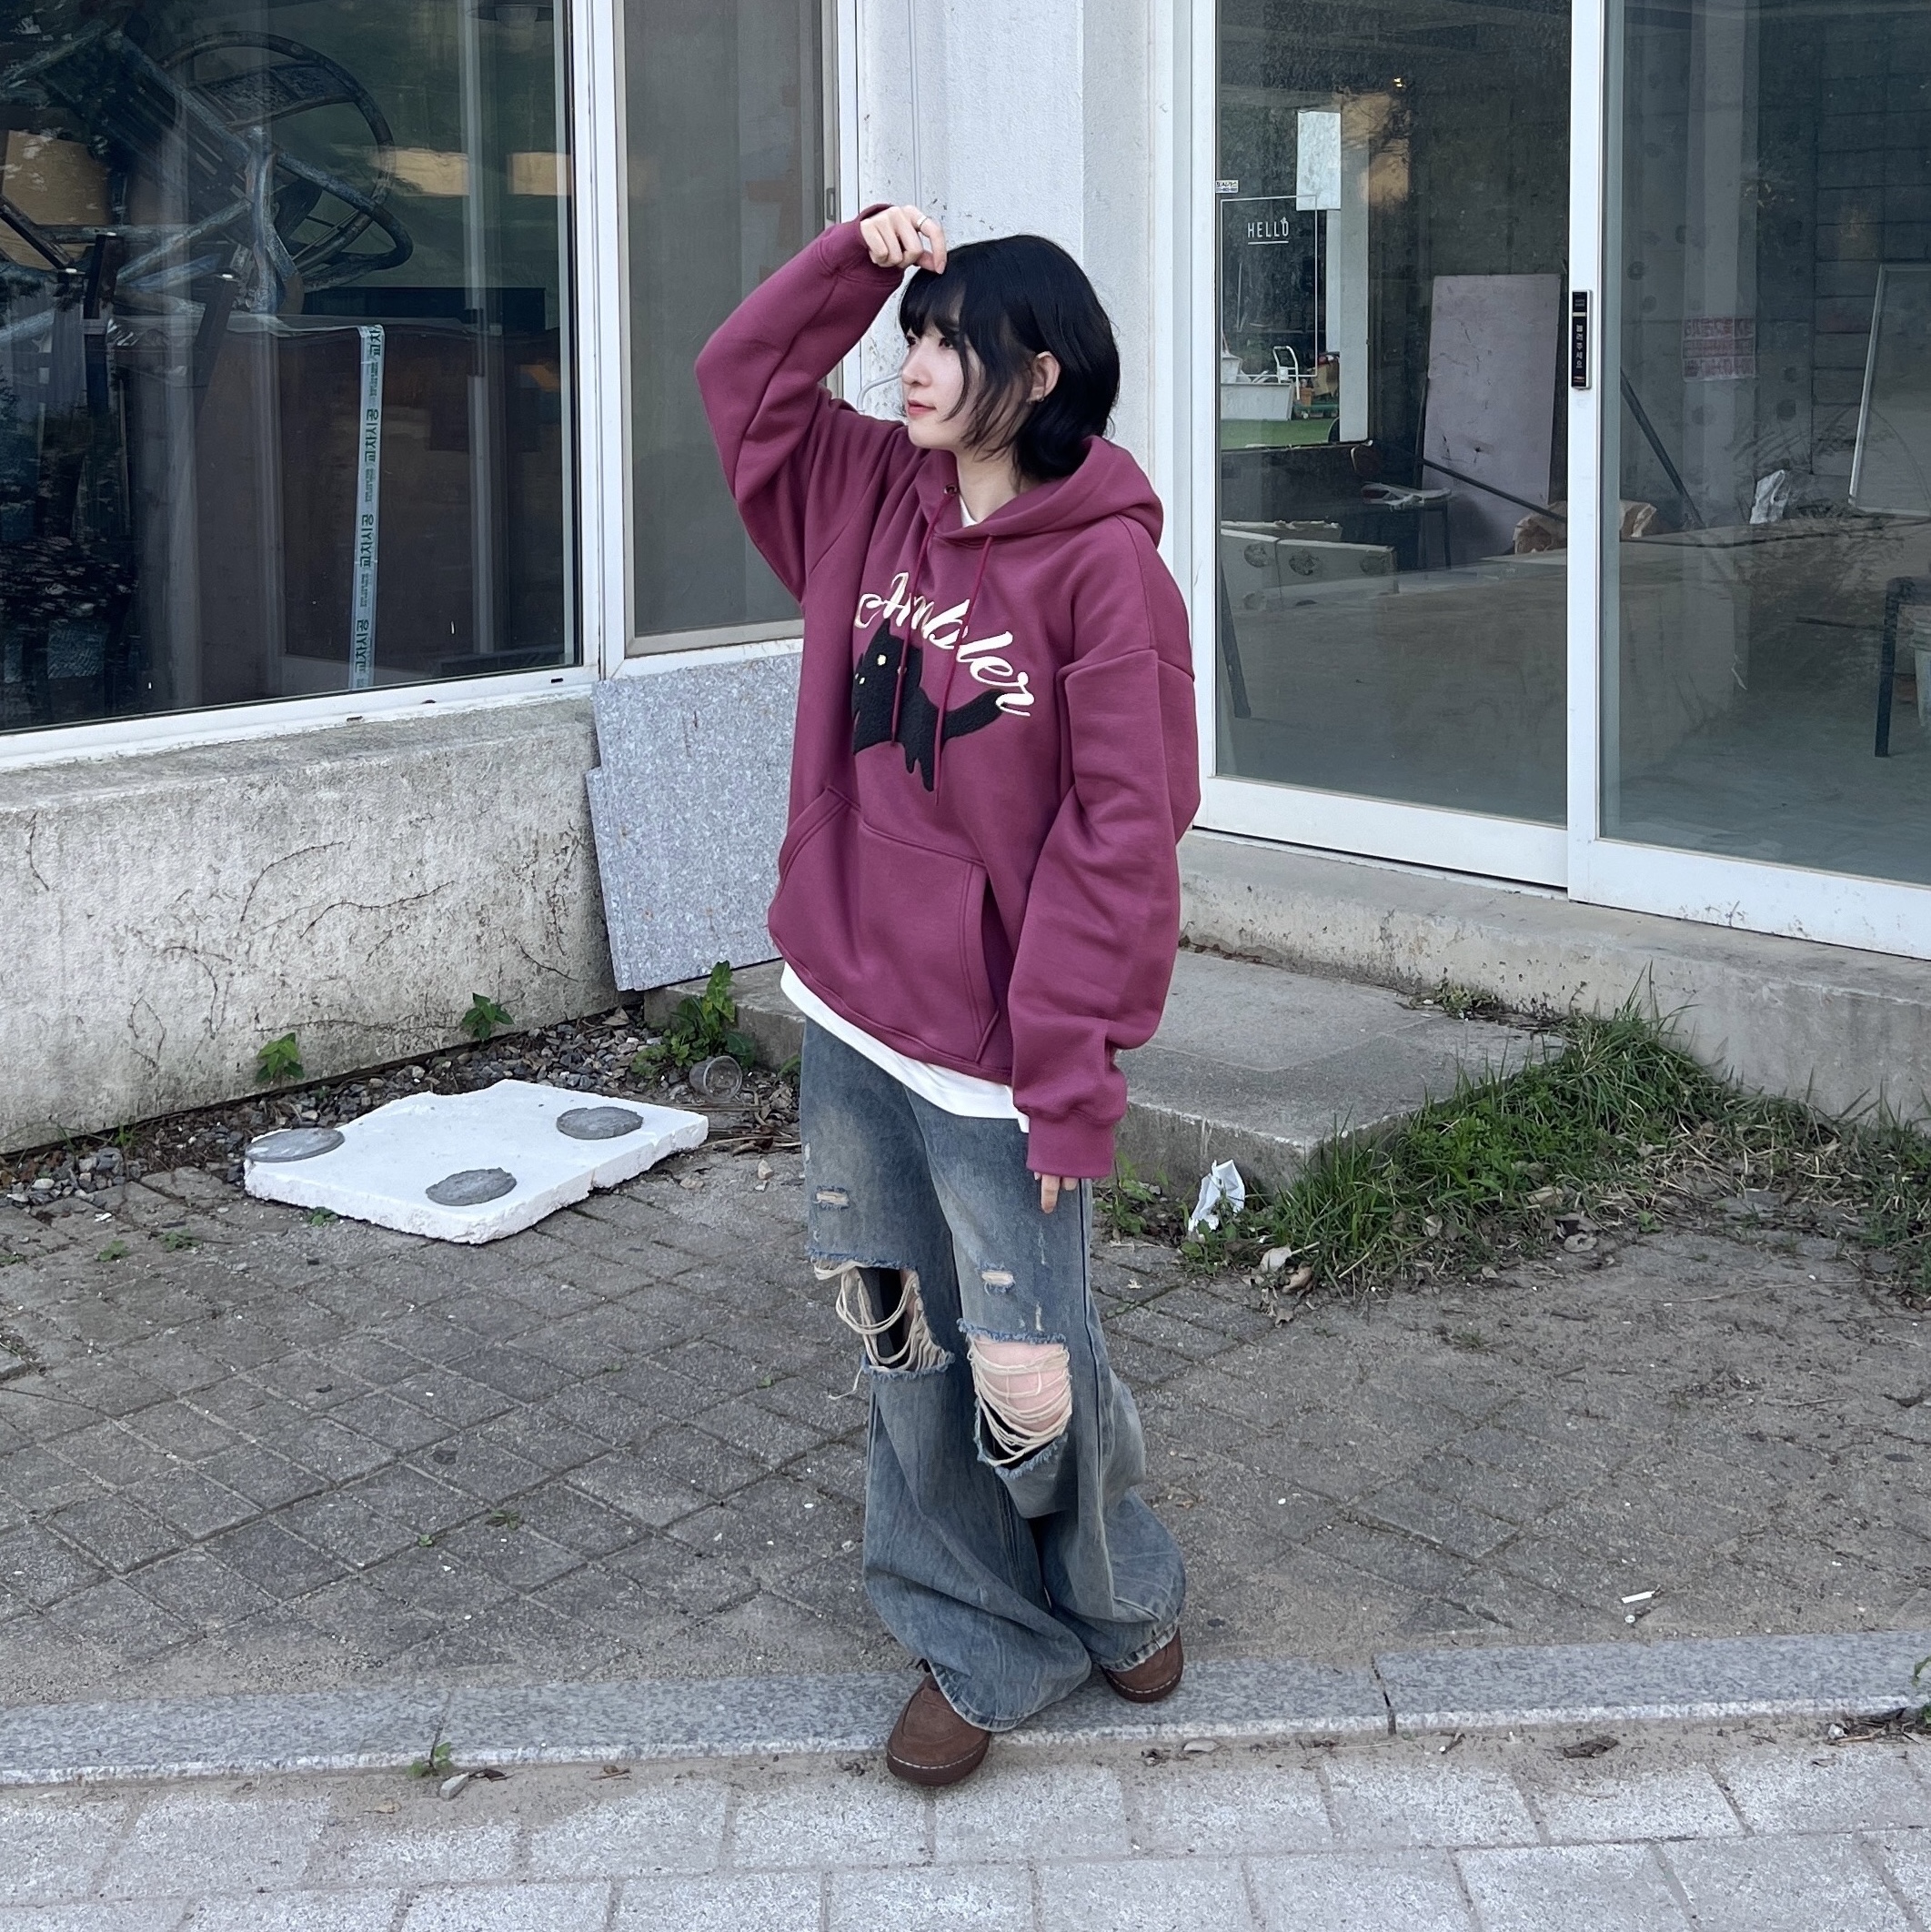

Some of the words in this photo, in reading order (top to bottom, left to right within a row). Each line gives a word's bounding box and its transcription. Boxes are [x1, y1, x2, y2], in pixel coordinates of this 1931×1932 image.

[1247, 219, 1289, 238] HELLO
[365, 408, 379, 463] 교차시공
[359, 513, 374, 568] 교차시공
[354, 619, 369, 673] 교차시공
[854, 571, 1035, 717] Ambler
